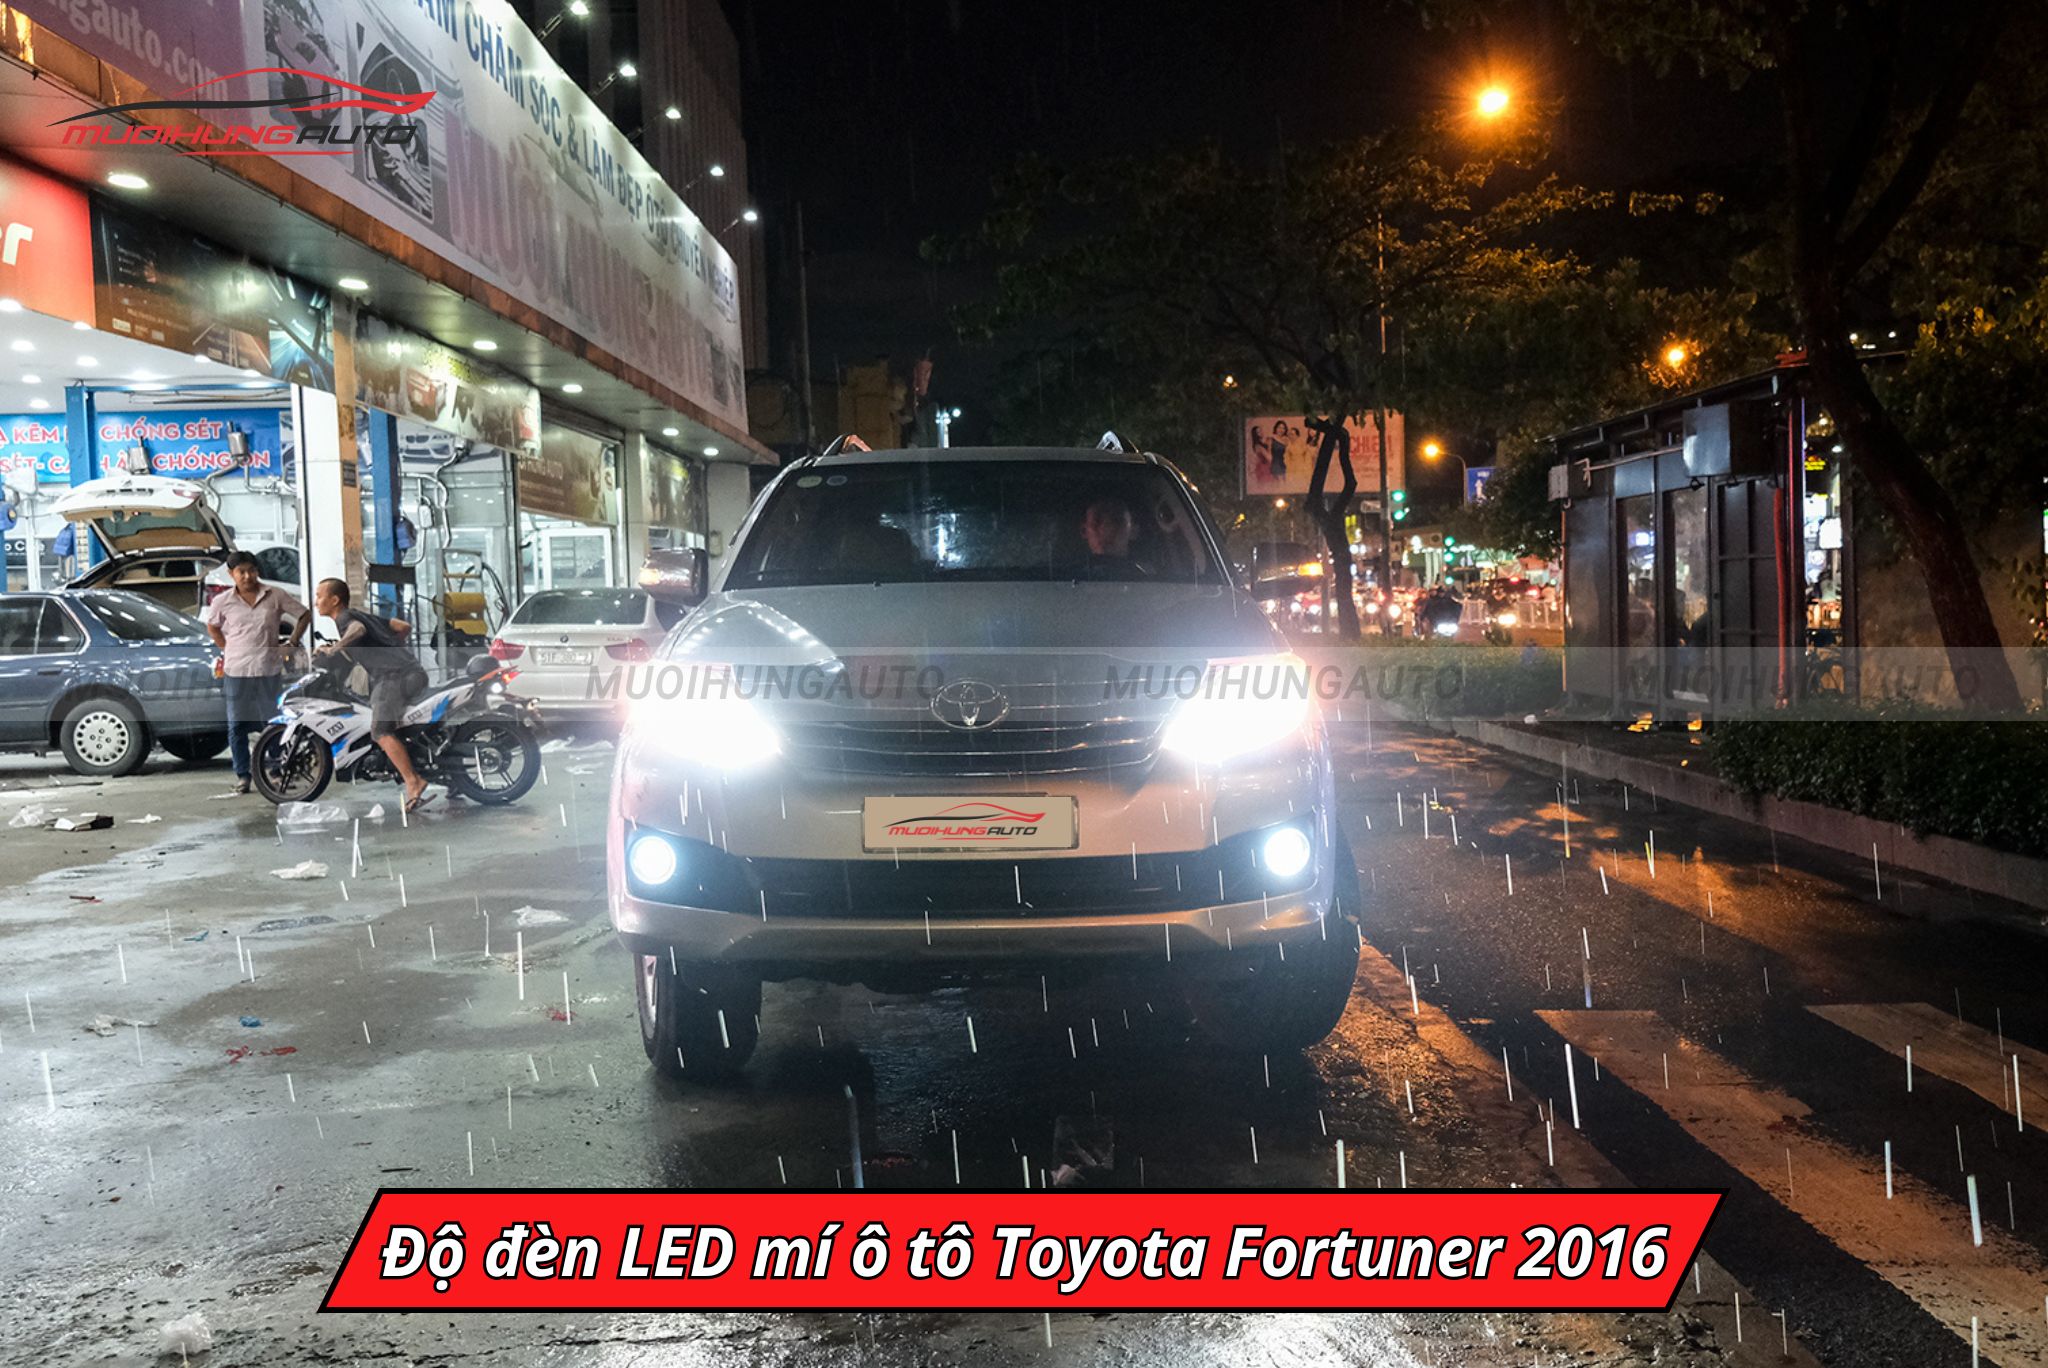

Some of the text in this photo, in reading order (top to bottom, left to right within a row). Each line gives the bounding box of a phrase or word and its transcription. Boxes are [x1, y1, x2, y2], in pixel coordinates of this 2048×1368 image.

[529, 76, 562, 147] SÓC
[568, 113, 580, 164] &
[583, 126, 614, 196] LÀM
[617, 163, 643, 222] ĐẸP
[100, 416, 180, 441] CHỐNG
[184, 416, 222, 440] SÉT
[152, 445, 231, 471] CHỐNG
